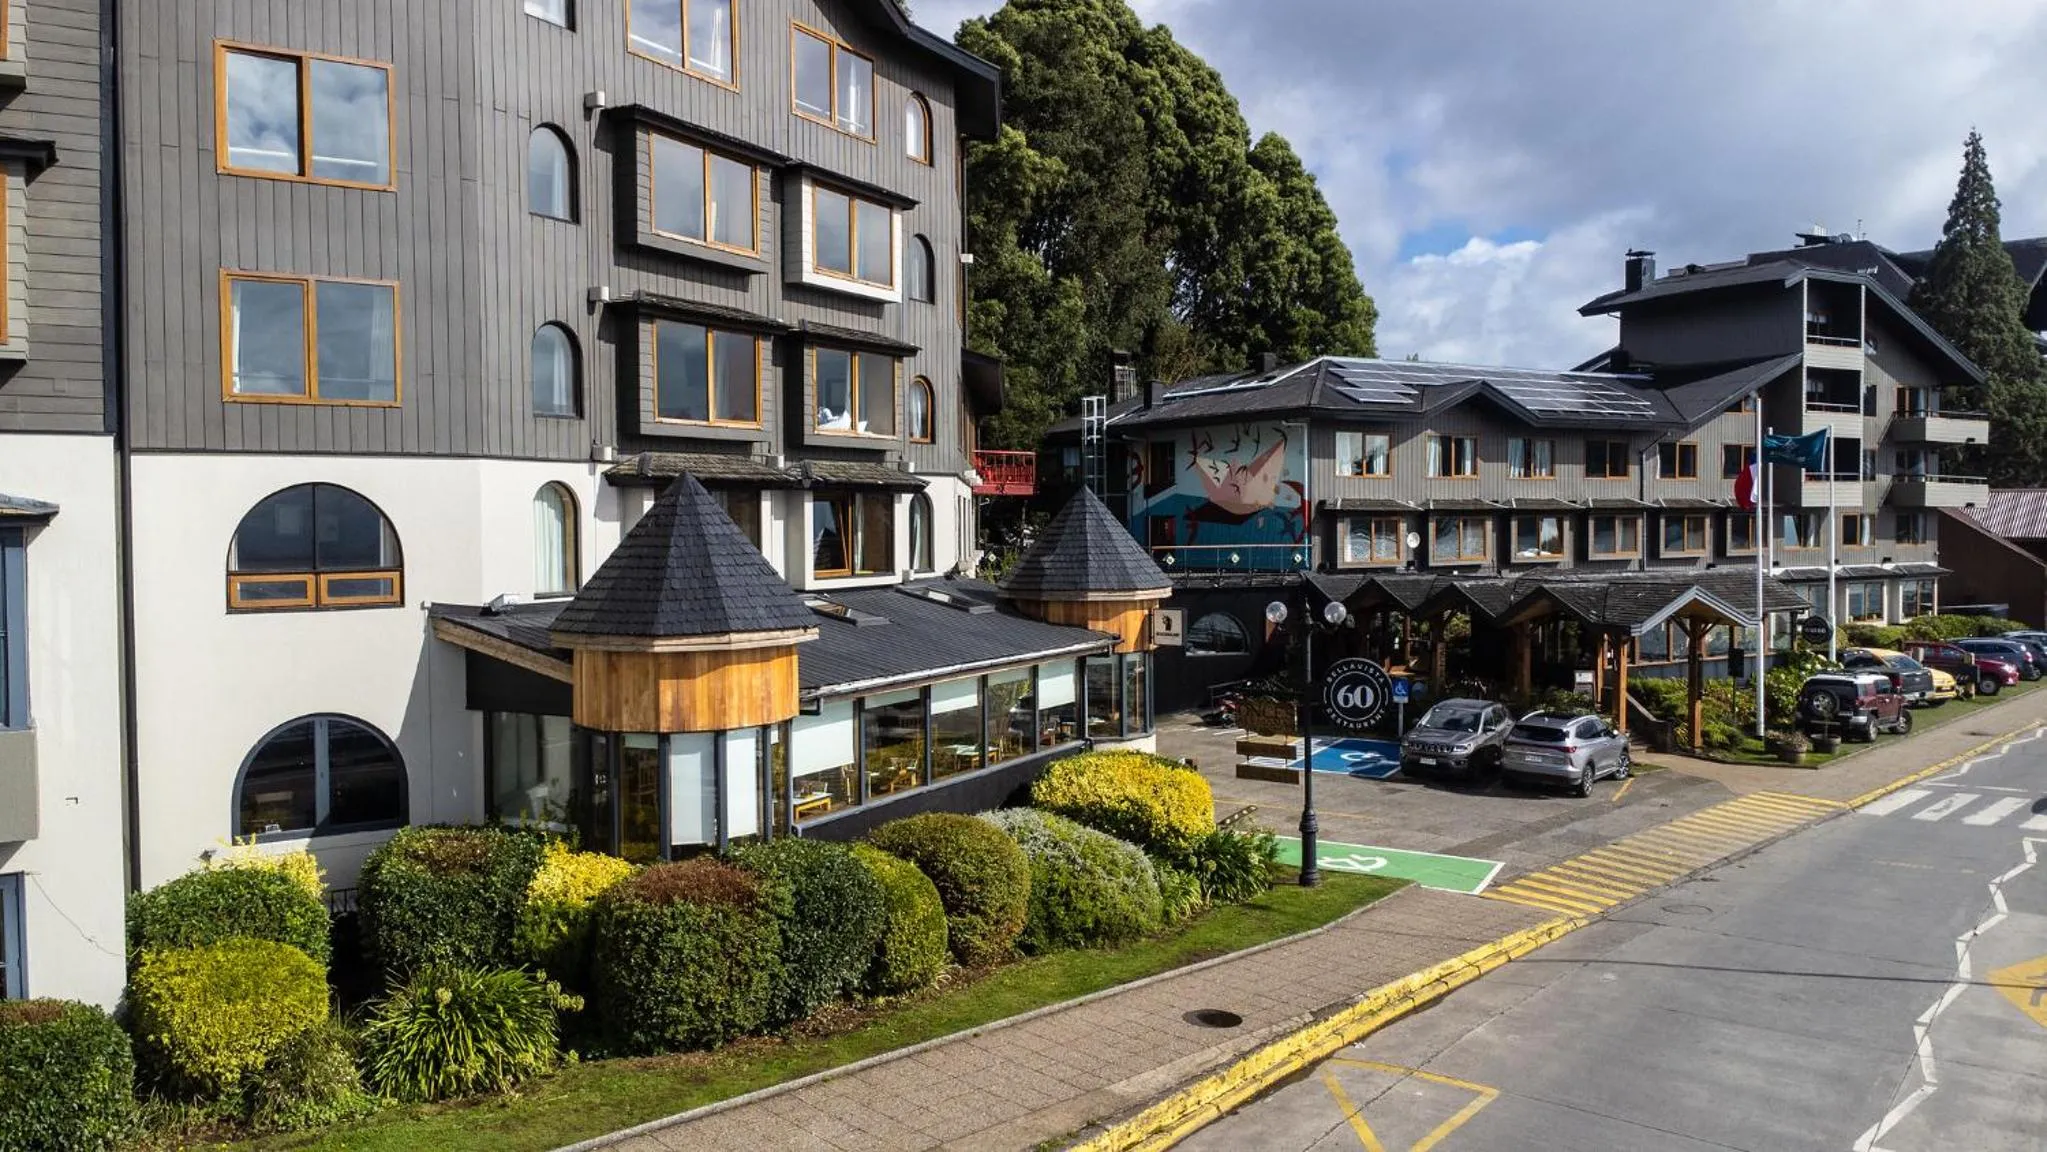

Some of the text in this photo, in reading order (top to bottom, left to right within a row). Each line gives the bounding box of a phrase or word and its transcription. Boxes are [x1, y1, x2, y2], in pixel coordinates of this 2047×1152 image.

[1326, 663, 1385, 683] BELLAVISTA
[1336, 684, 1374, 708] 60
[1326, 707, 1385, 729] RESTAURANT
